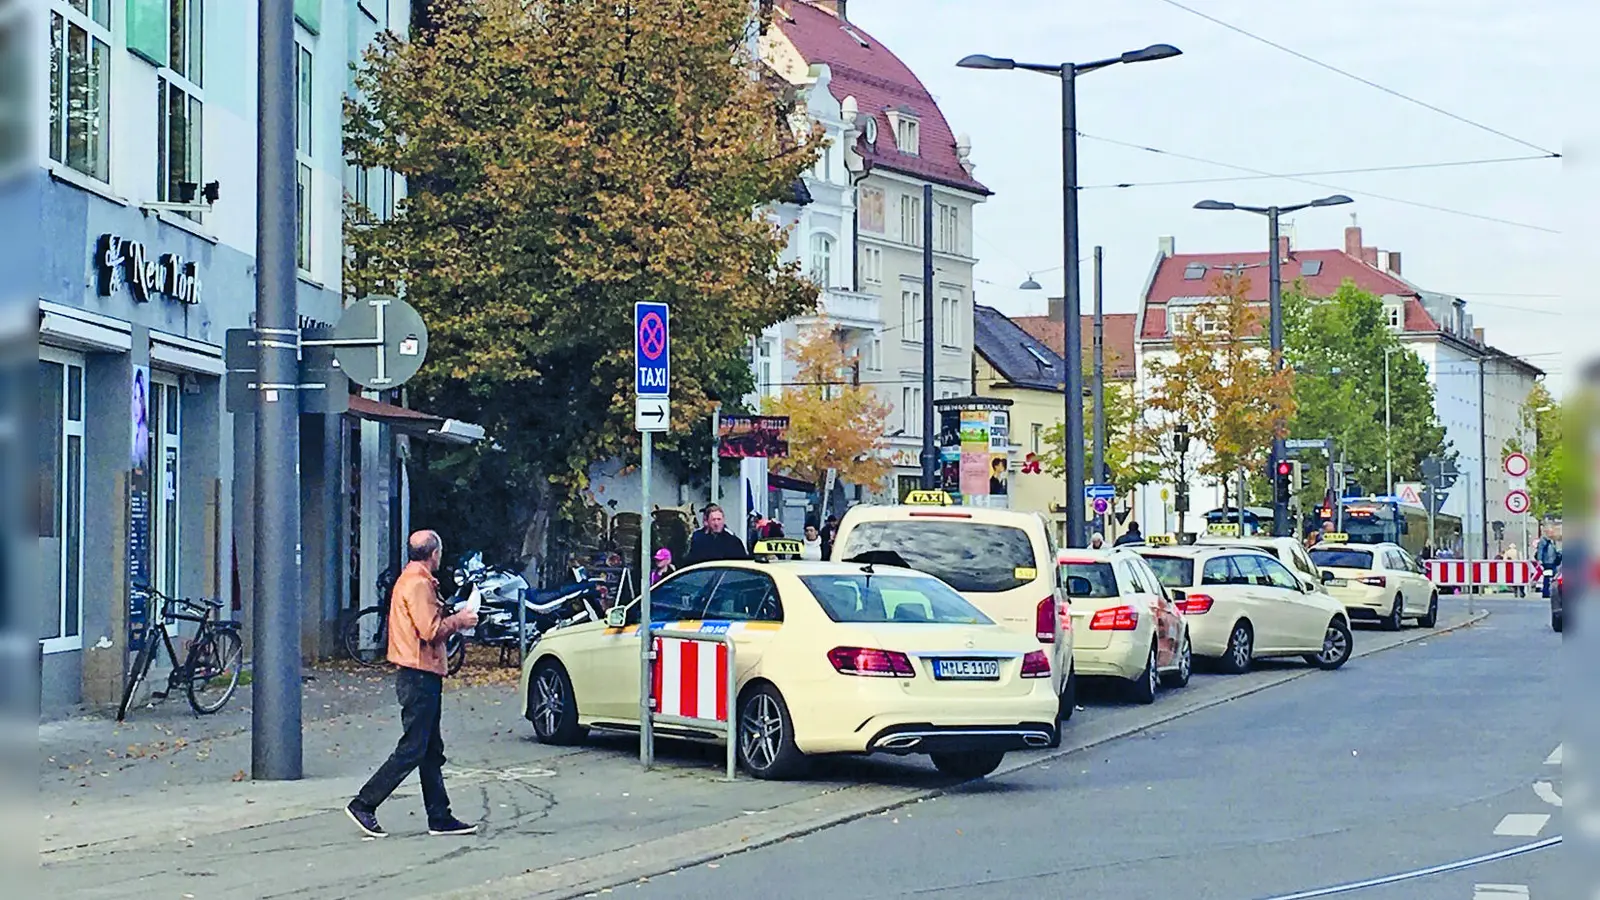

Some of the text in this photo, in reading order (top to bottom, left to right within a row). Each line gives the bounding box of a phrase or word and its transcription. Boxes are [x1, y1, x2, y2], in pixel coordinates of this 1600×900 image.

[129, 239, 167, 302] New
[169, 252, 202, 304] York
[639, 366, 666, 387] TAXI
[914, 493, 943, 502] TAXI
[1513, 496, 1521, 508] 5
[769, 542, 798, 553] TAXI
[941, 662, 949, 675] M
